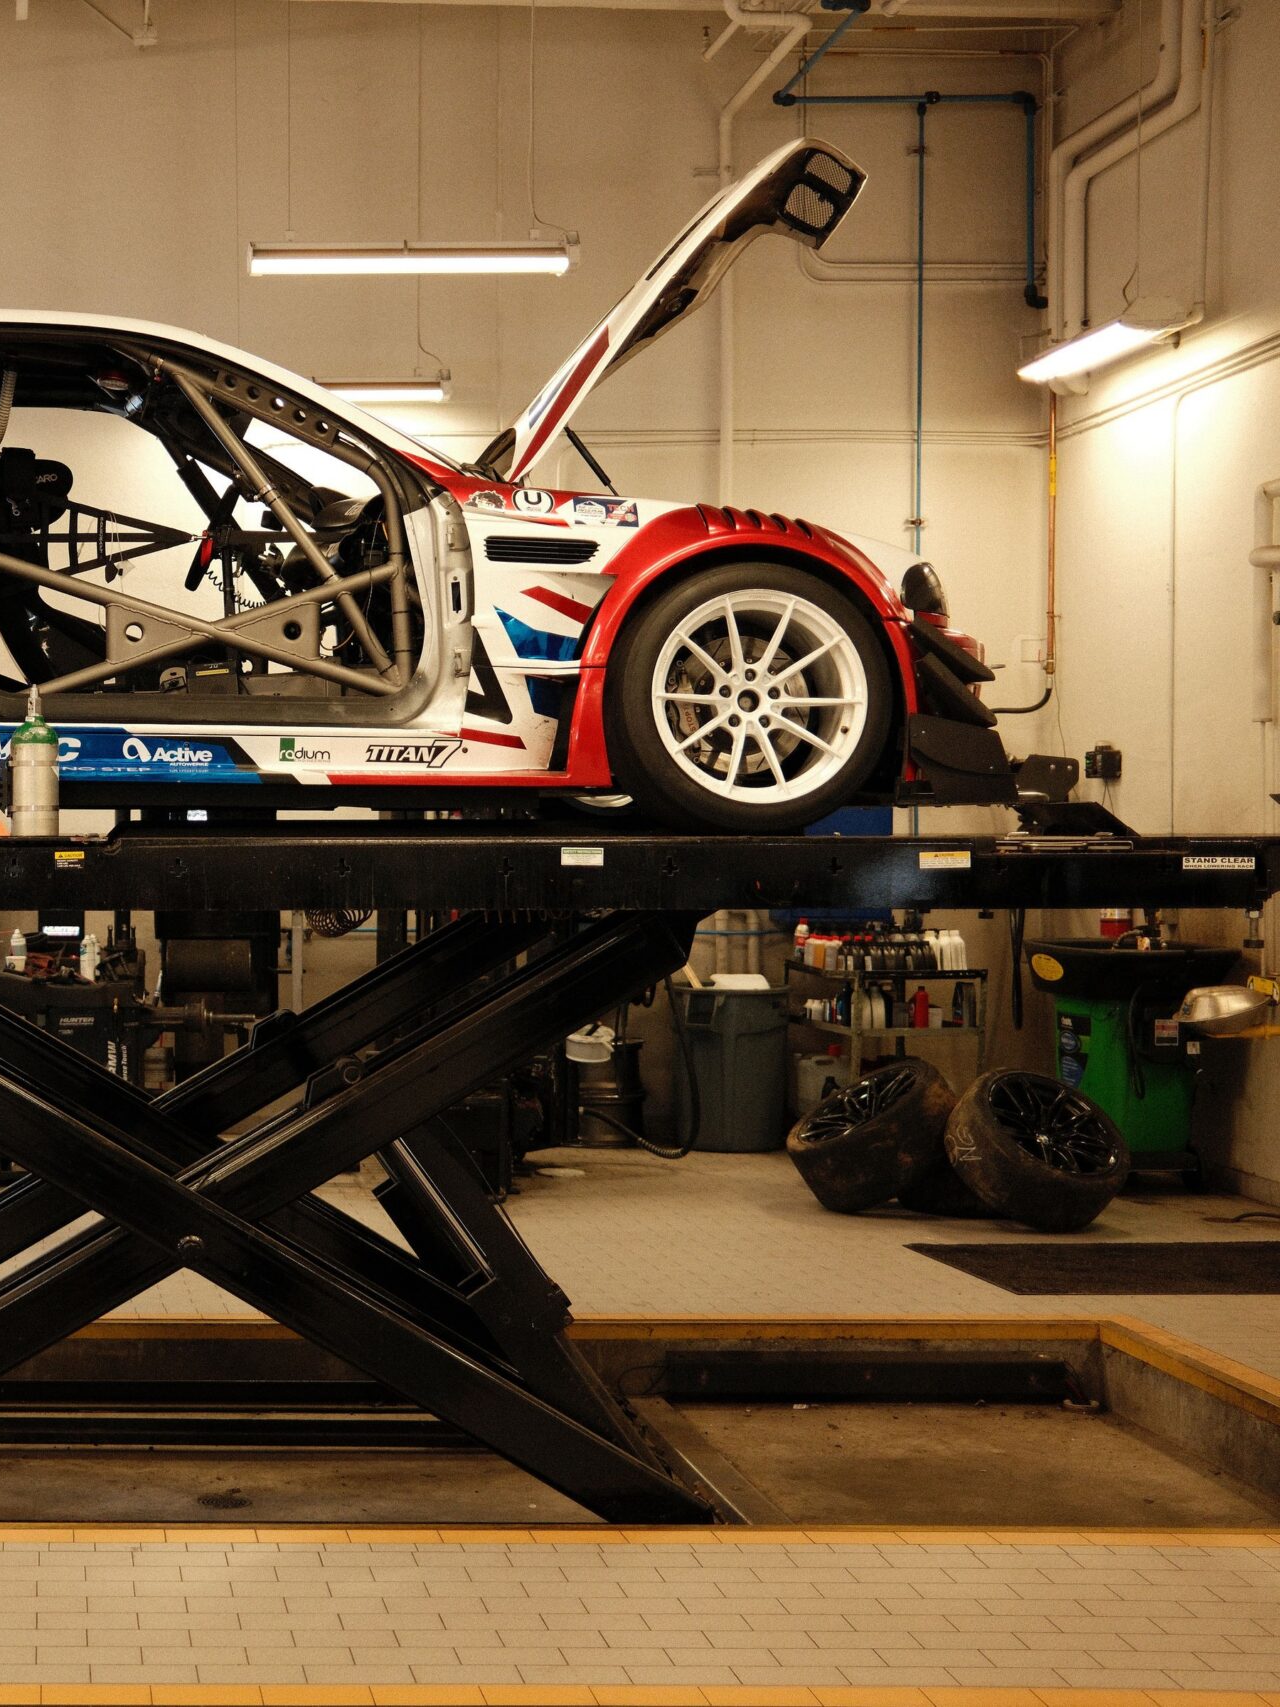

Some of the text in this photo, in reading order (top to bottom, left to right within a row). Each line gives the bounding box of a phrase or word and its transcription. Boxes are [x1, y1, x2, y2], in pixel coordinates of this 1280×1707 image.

[36, 474, 58, 484] ARO
[523, 490, 542, 505] U
[152, 746, 213, 763] Active
[279, 746, 331, 762] radium
